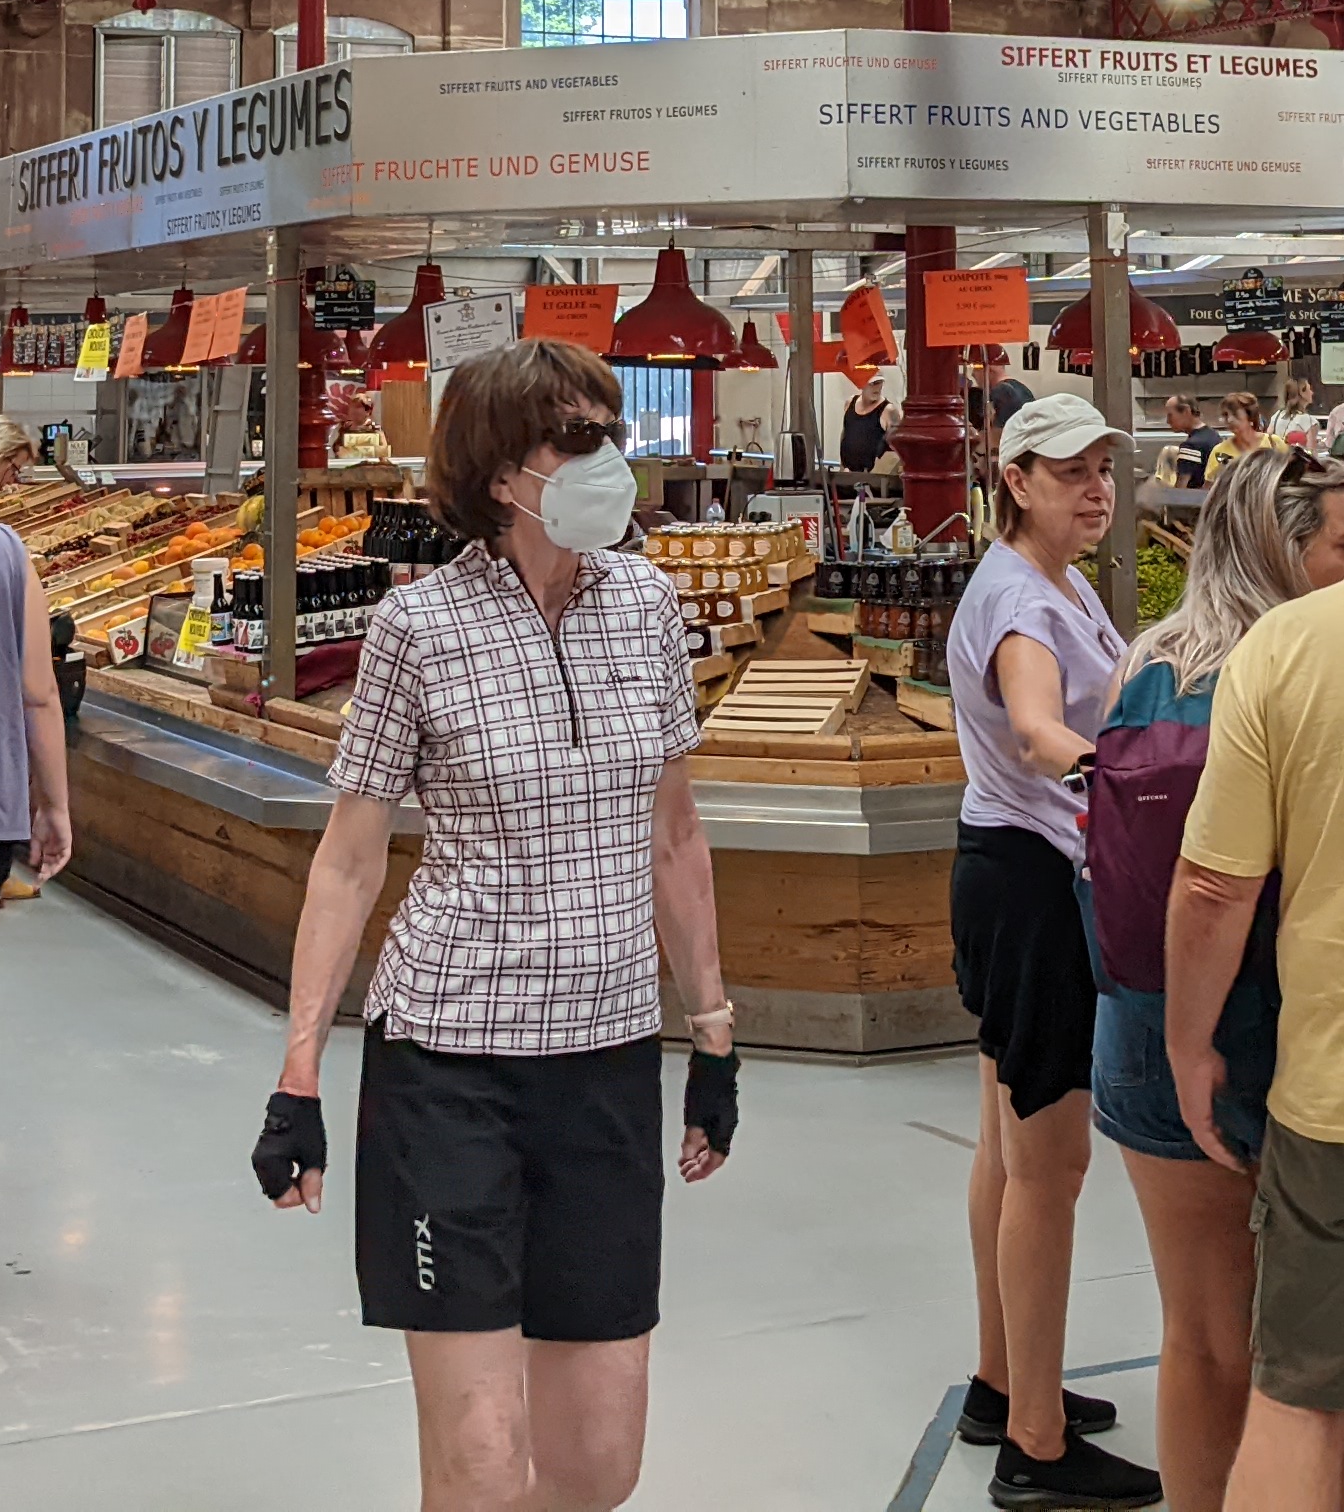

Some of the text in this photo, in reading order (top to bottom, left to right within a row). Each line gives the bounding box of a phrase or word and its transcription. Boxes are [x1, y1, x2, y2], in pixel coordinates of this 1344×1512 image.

[763, 56, 938, 71] SIFFERT FRUCHTE UND GEMUSE
[1001, 46, 1318, 78] SIFFERT FRUITS ET LEGUMES
[439, 75, 619, 95] SIFFERT FRUITS AND VEGETABLES
[1058, 73, 1202, 88] SIFFERT FRUITS ET LEGUMES
[562, 104, 717, 123] SIFFERT FRUTOS Y LEGUMES
[819, 104, 1220, 134] SIFFERT FRUITS AND VEGETABLES
[1278, 111, 1316, 123] SIFFERT
[18, 142, 93, 212] SIFFERT
[98, 115, 185, 195] FRUTOS
[193, 107, 209, 172] Y
[218, 69, 352, 167] LEGUMES
[321, 150, 651, 187] SIFFERT FRUCHTE UND GEMUSE
[857, 157, 1009, 171] SIFFERT FRUTOS Y LEGUMES
[1146, 158, 1302, 172] SIFFERT FRUCHTE UND GEMUSE
[167, 203, 261, 236] SIFFERT FRUTOS Y LEGUMES
[942, 273, 991, 282] COMPOTE
[545, 288, 598, 296] CONFITURE
[1190, 309, 1212, 320] FOIE
[1299, 309, 1321, 320] SPÉC
[413, 1212, 435, 1291] OTIX
